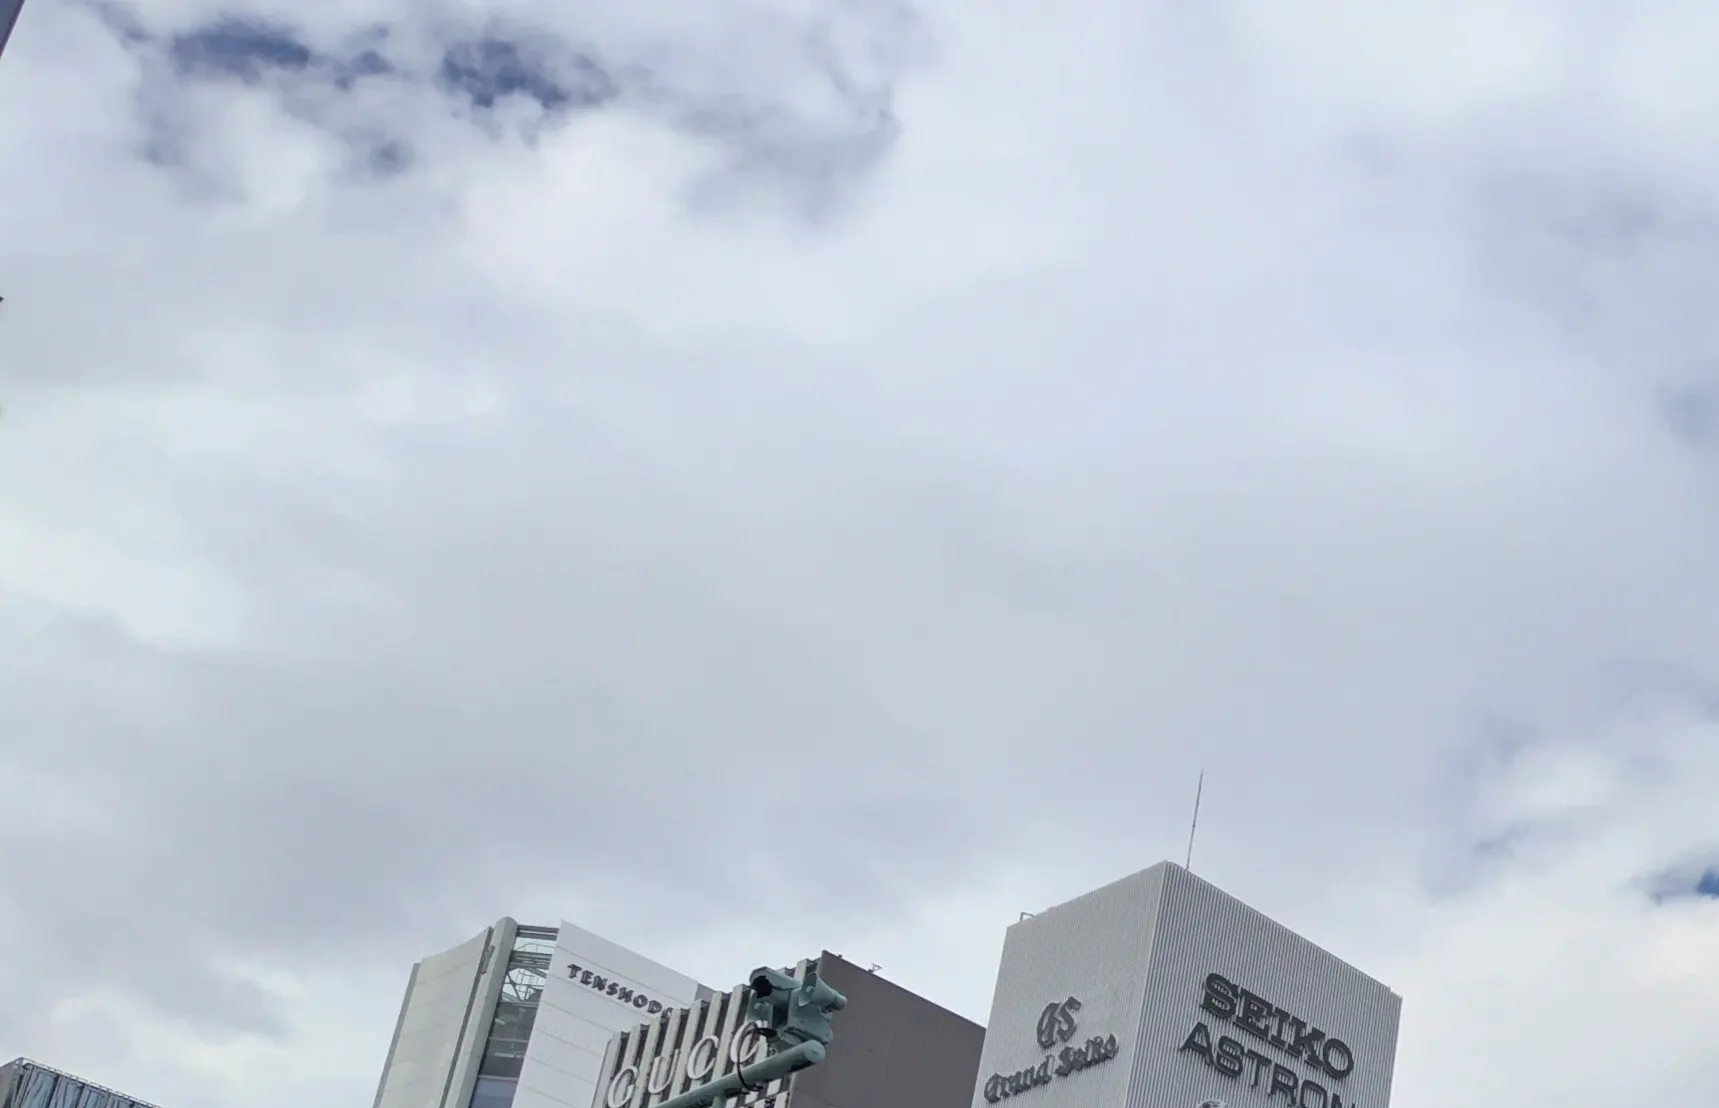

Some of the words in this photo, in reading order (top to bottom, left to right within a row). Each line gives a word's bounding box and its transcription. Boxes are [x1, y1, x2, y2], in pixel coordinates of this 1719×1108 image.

[1037, 996, 1081, 1048] GS
[1201, 972, 1354, 1079] SEIKO
[608, 1020, 768, 1108] GUCC
[984, 1054, 1054, 1101] Grand
[1055, 1033, 1119, 1077] Seiko
